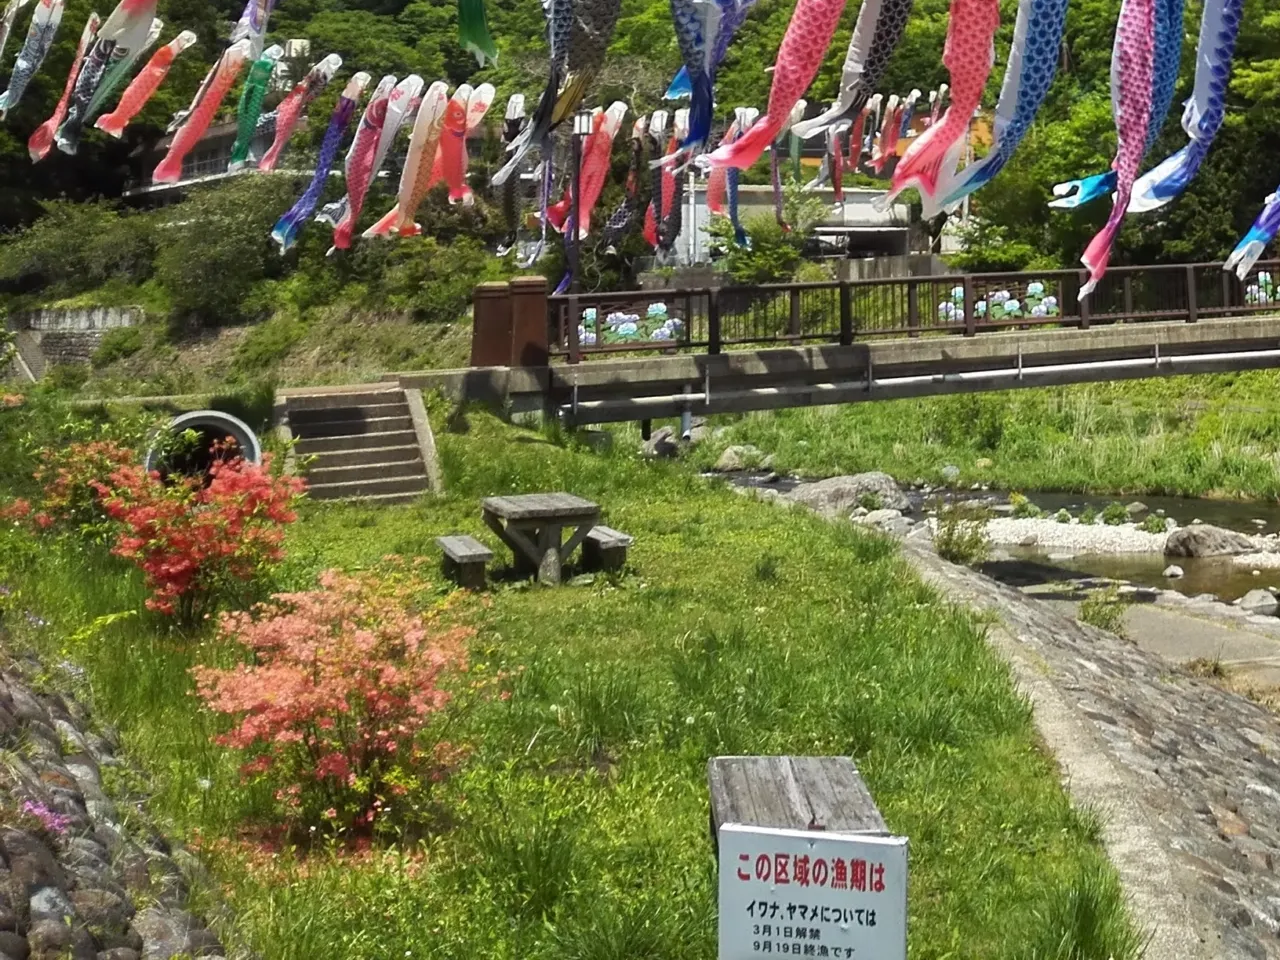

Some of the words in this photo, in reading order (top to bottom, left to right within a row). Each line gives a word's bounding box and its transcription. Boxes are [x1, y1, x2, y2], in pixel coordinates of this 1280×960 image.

[737, 853, 886, 892] この区域の漁期は
[753, 925, 821, 940] 3月1日解禁
[753, 941, 856, 959] 9月19日終漁です
